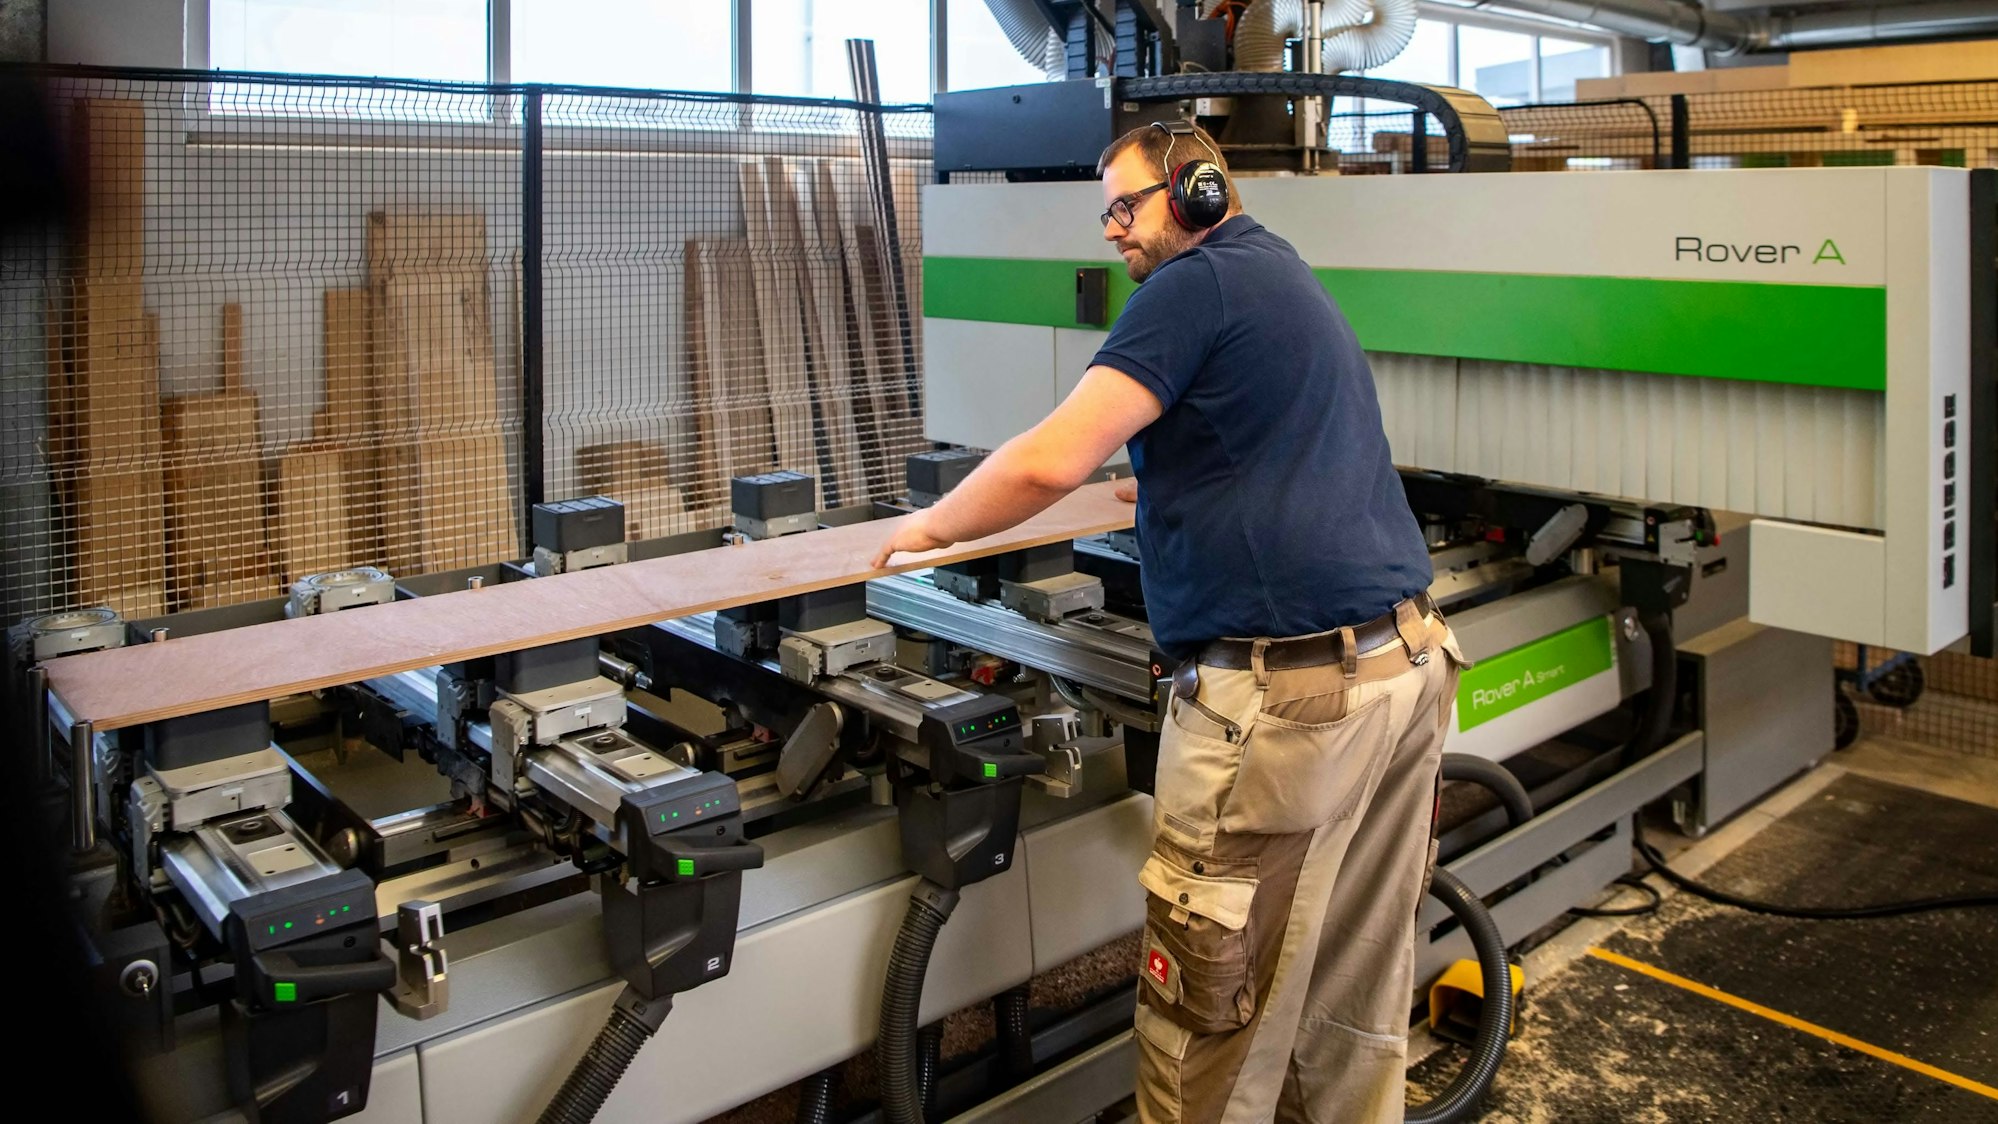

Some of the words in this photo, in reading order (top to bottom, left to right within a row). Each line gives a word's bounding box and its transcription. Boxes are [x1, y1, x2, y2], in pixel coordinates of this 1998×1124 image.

[1675, 237, 1800, 264] Rover
[1812, 238, 1846, 265] A
[1472, 678, 1520, 710] Rover
[1522, 670, 1535, 689] A
[1536, 664, 1565, 684] Smart
[994, 853, 1005, 865] 3
[707, 956, 720, 971] 2
[336, 1090, 349, 1104] 1
